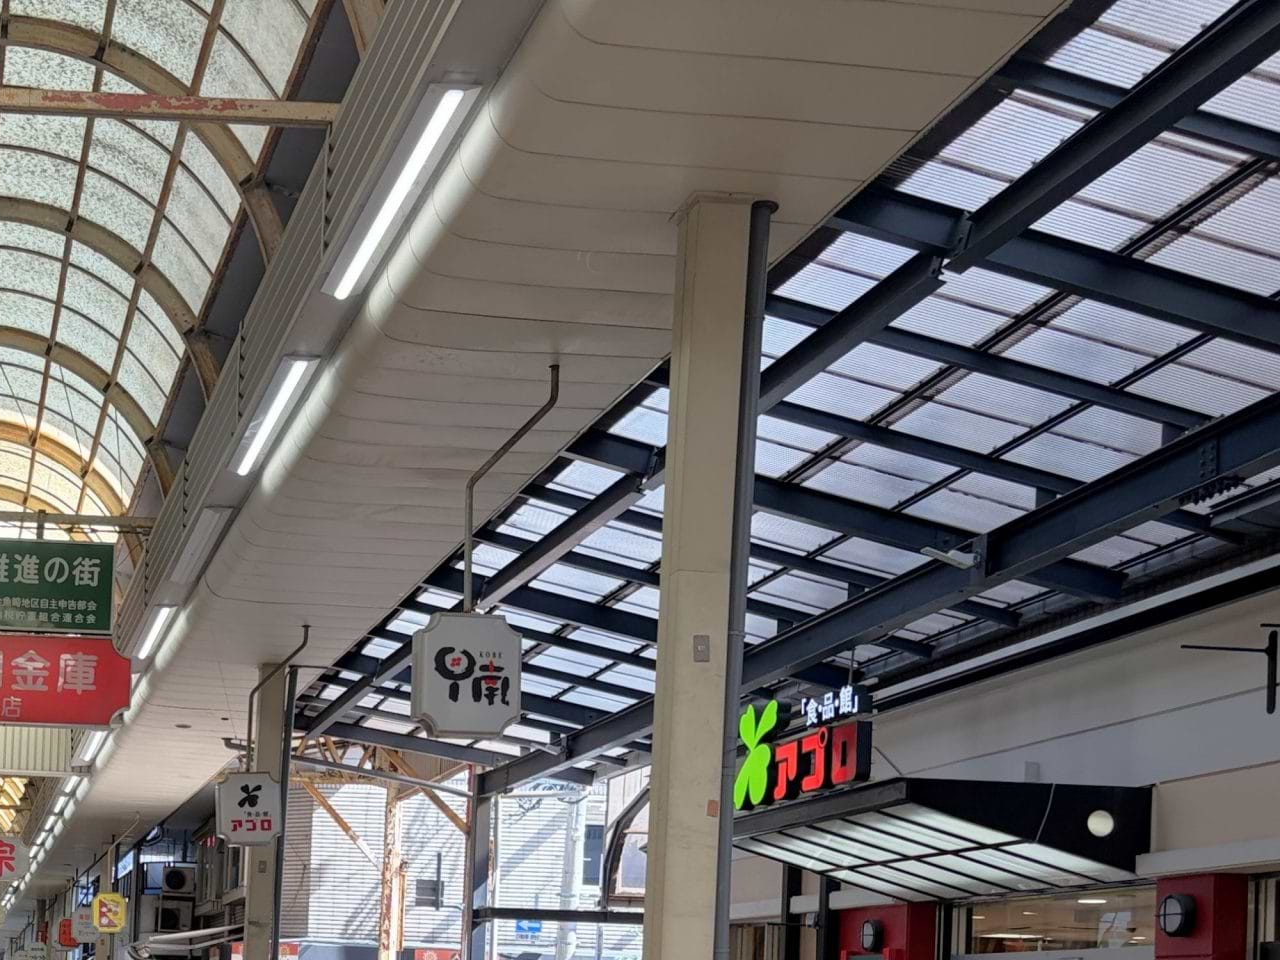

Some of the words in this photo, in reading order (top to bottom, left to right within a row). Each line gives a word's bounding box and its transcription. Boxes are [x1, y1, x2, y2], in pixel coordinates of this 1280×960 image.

[479, 650, 504, 659] KOBE
[773, 727, 859, 801] アプロ
